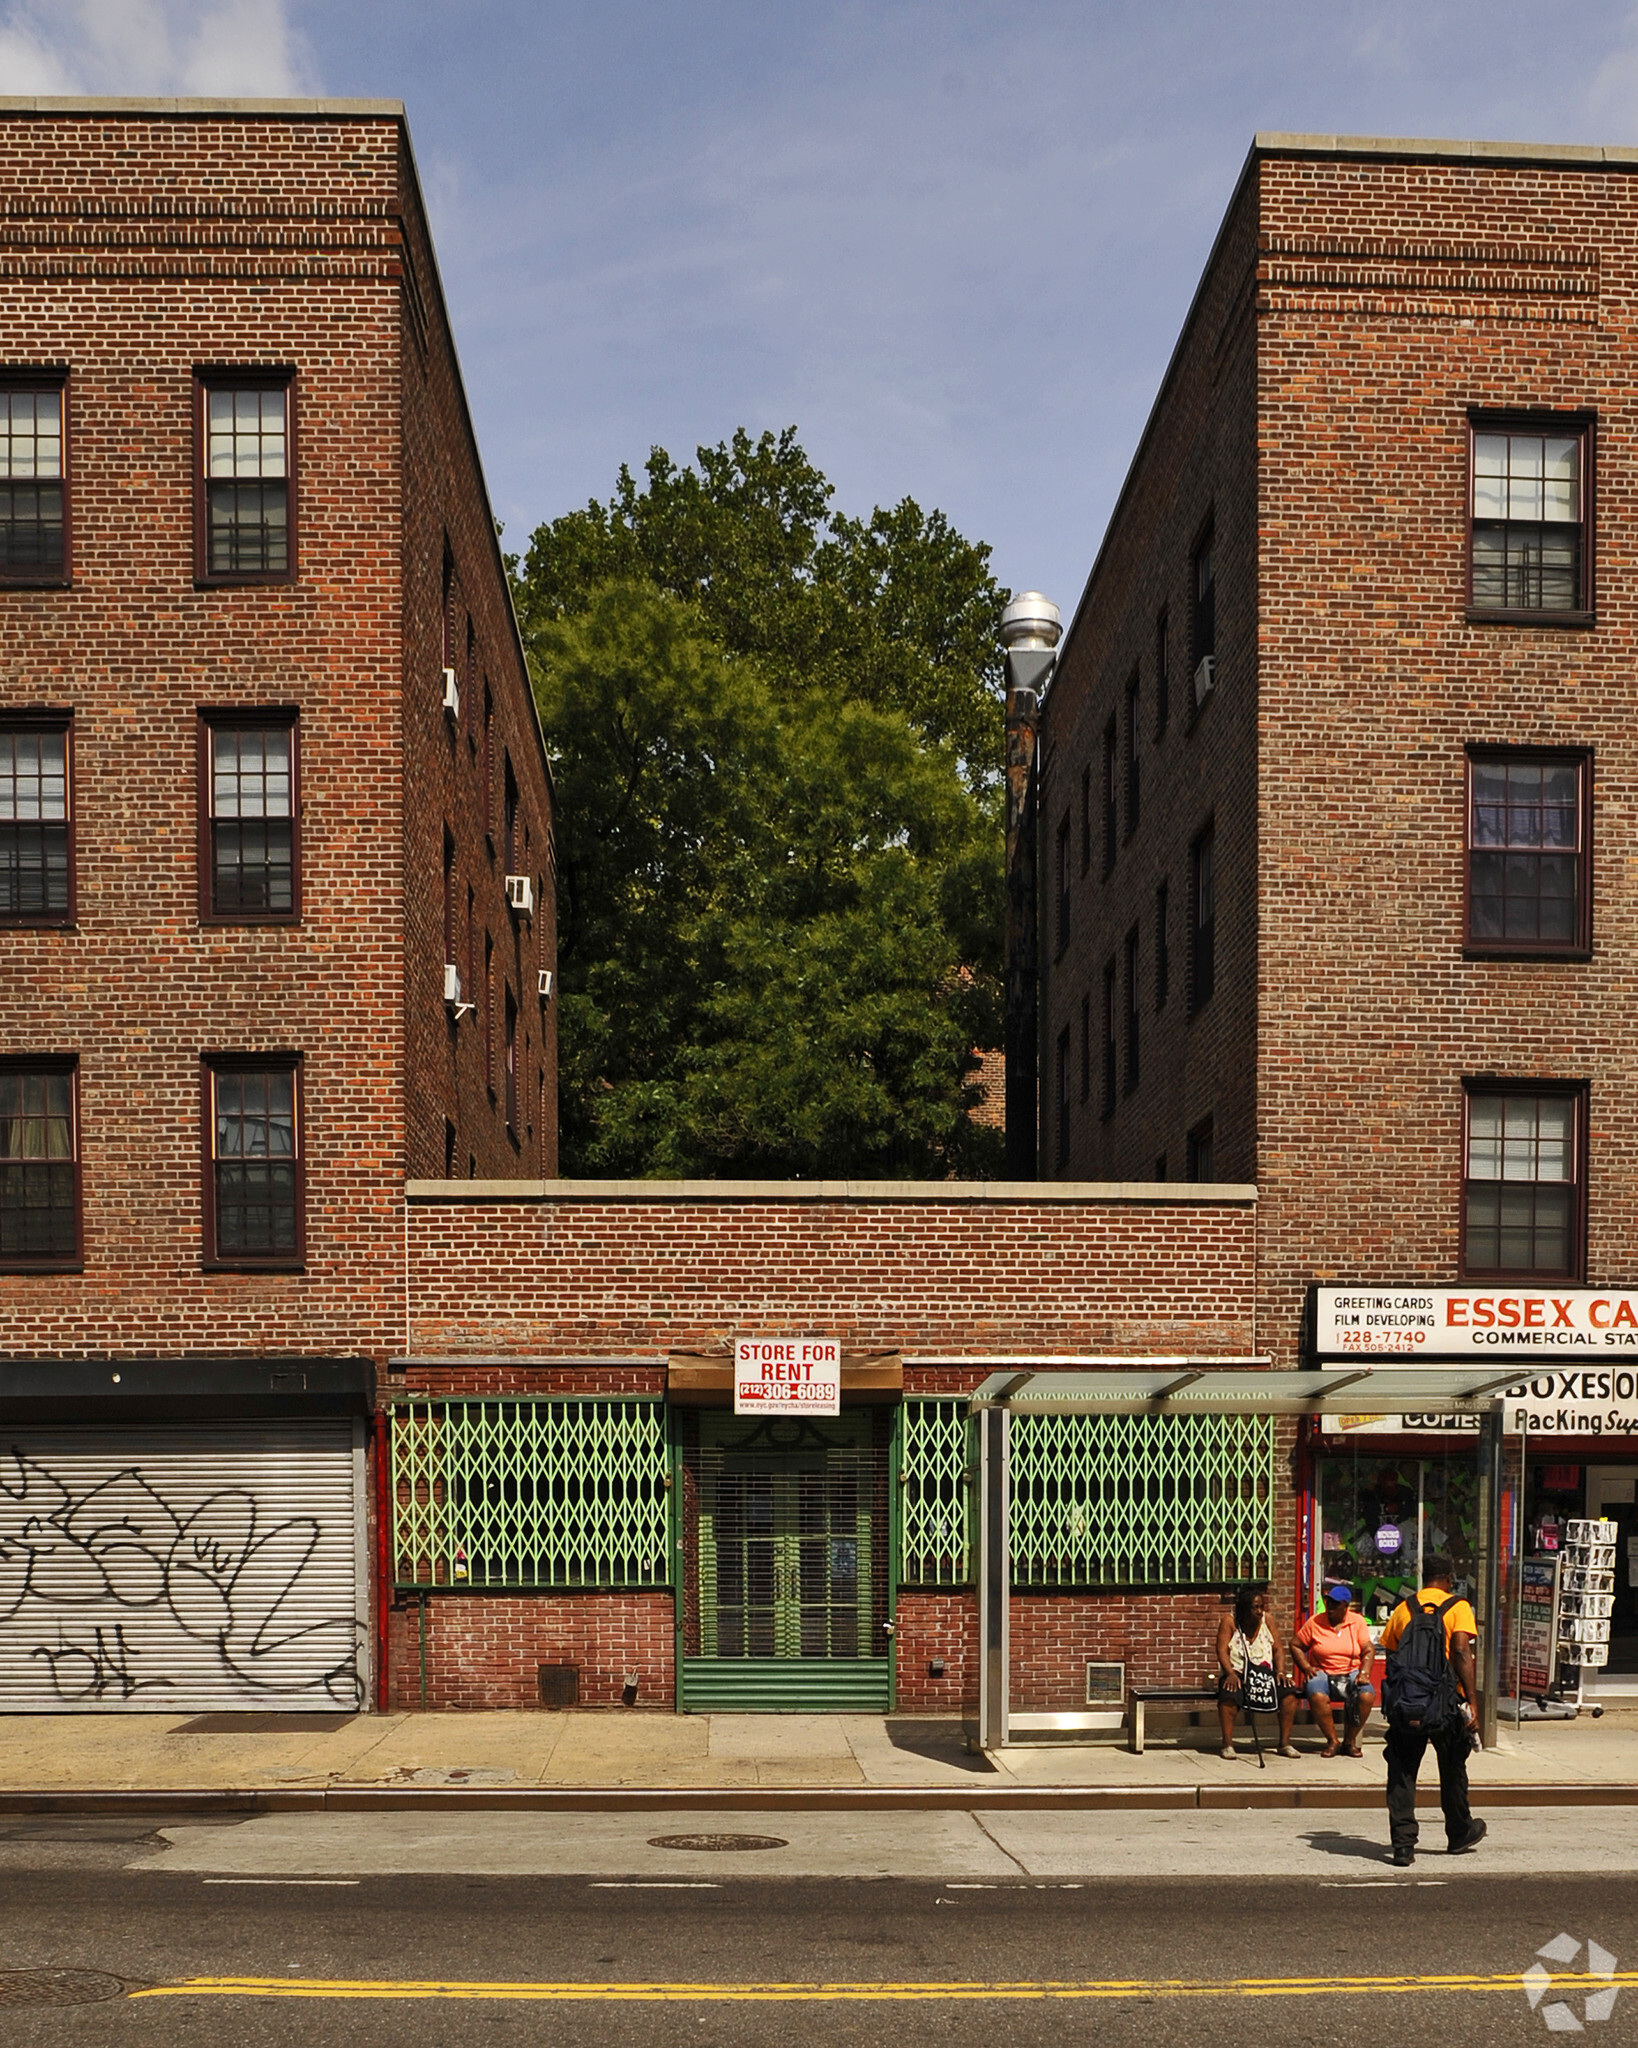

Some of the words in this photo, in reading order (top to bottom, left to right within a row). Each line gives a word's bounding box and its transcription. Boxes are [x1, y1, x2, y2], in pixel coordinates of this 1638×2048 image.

[1334, 1297, 1391, 1309] GREETING
[1394, 1297, 1433, 1309] CARDS
[1446, 1298, 1575, 1328] ESSEX
[1588, 1299, 1638, 1328] CA
[1334, 1314, 1360, 1326] FILM
[1366, 1314, 1435, 1326] DEVELOPING
[1472, 1331, 1597, 1345] COMMERCIAL
[740, 1344, 795, 1360] STORE
[803, 1345, 835, 1360] FOR
[1342, 1343, 1362, 1352] FAX
[761, 1363, 814, 1380] RENT
[1249, 1677, 1272, 1689] LOVE
